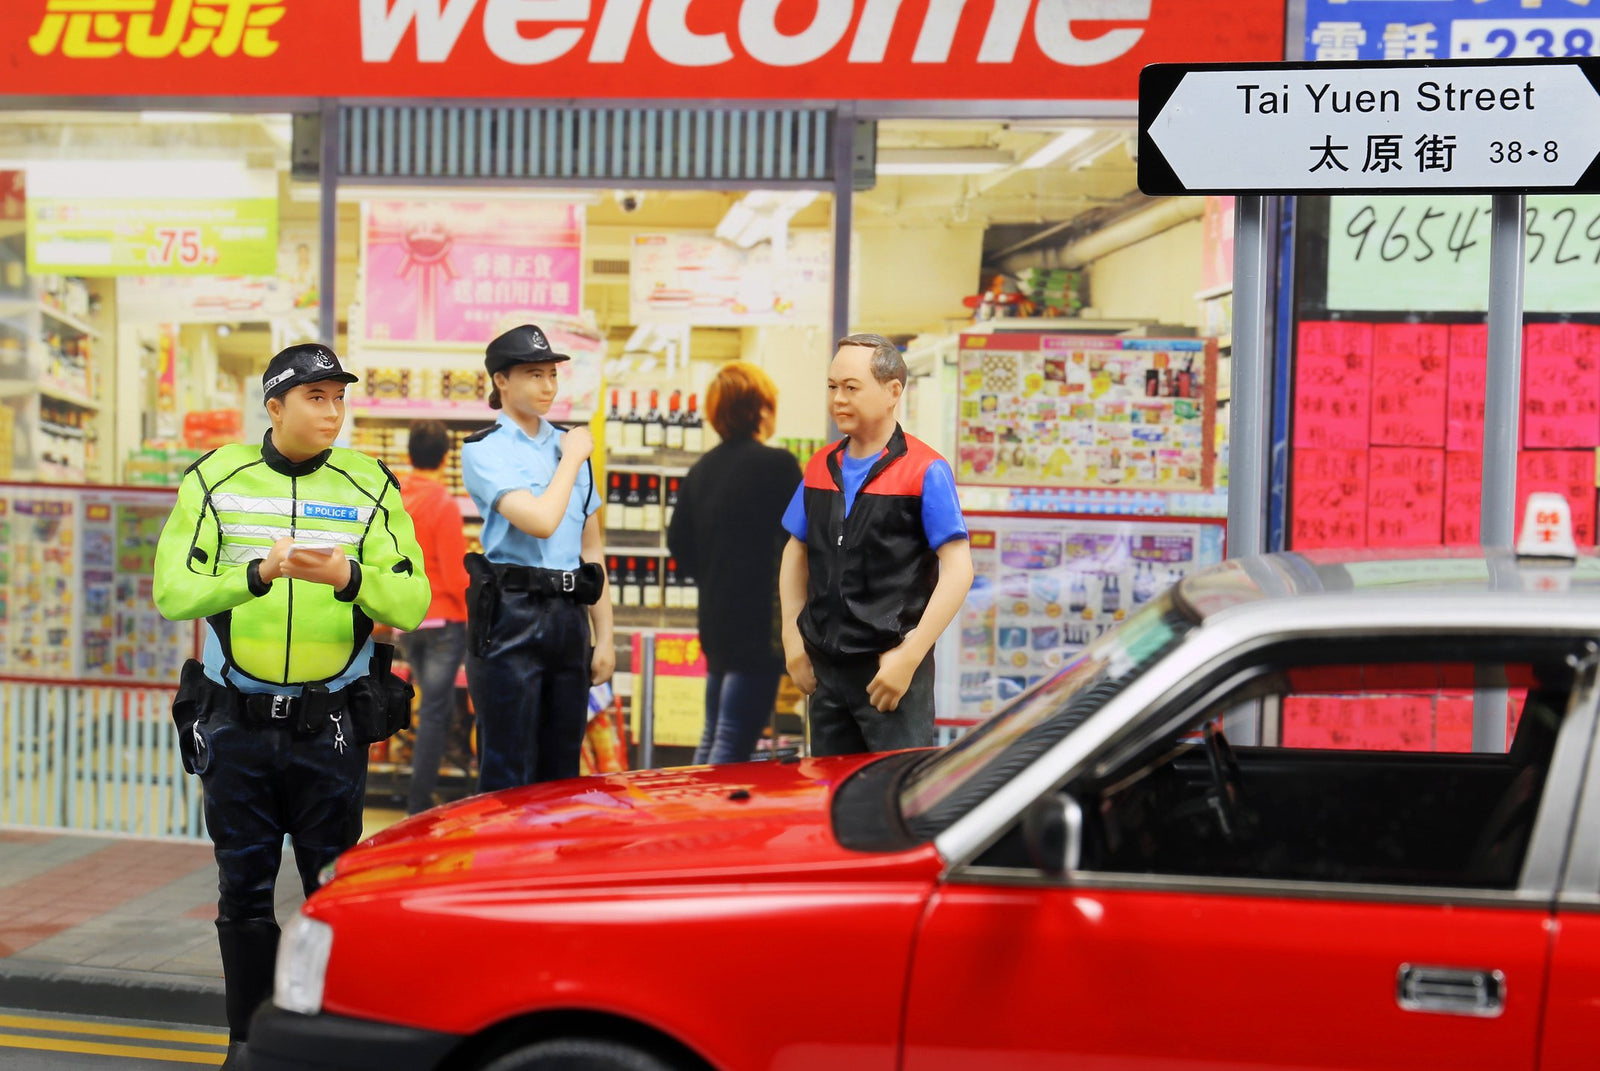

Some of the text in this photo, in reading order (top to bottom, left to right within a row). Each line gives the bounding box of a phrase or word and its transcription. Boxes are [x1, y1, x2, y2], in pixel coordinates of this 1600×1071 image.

[1311, 22, 1438, 60] 電話
[1236, 81, 1535, 114] Tai Yuen Street
[1308, 133, 1457, 173] 太原街
[315, 507, 347, 518] POLICE
